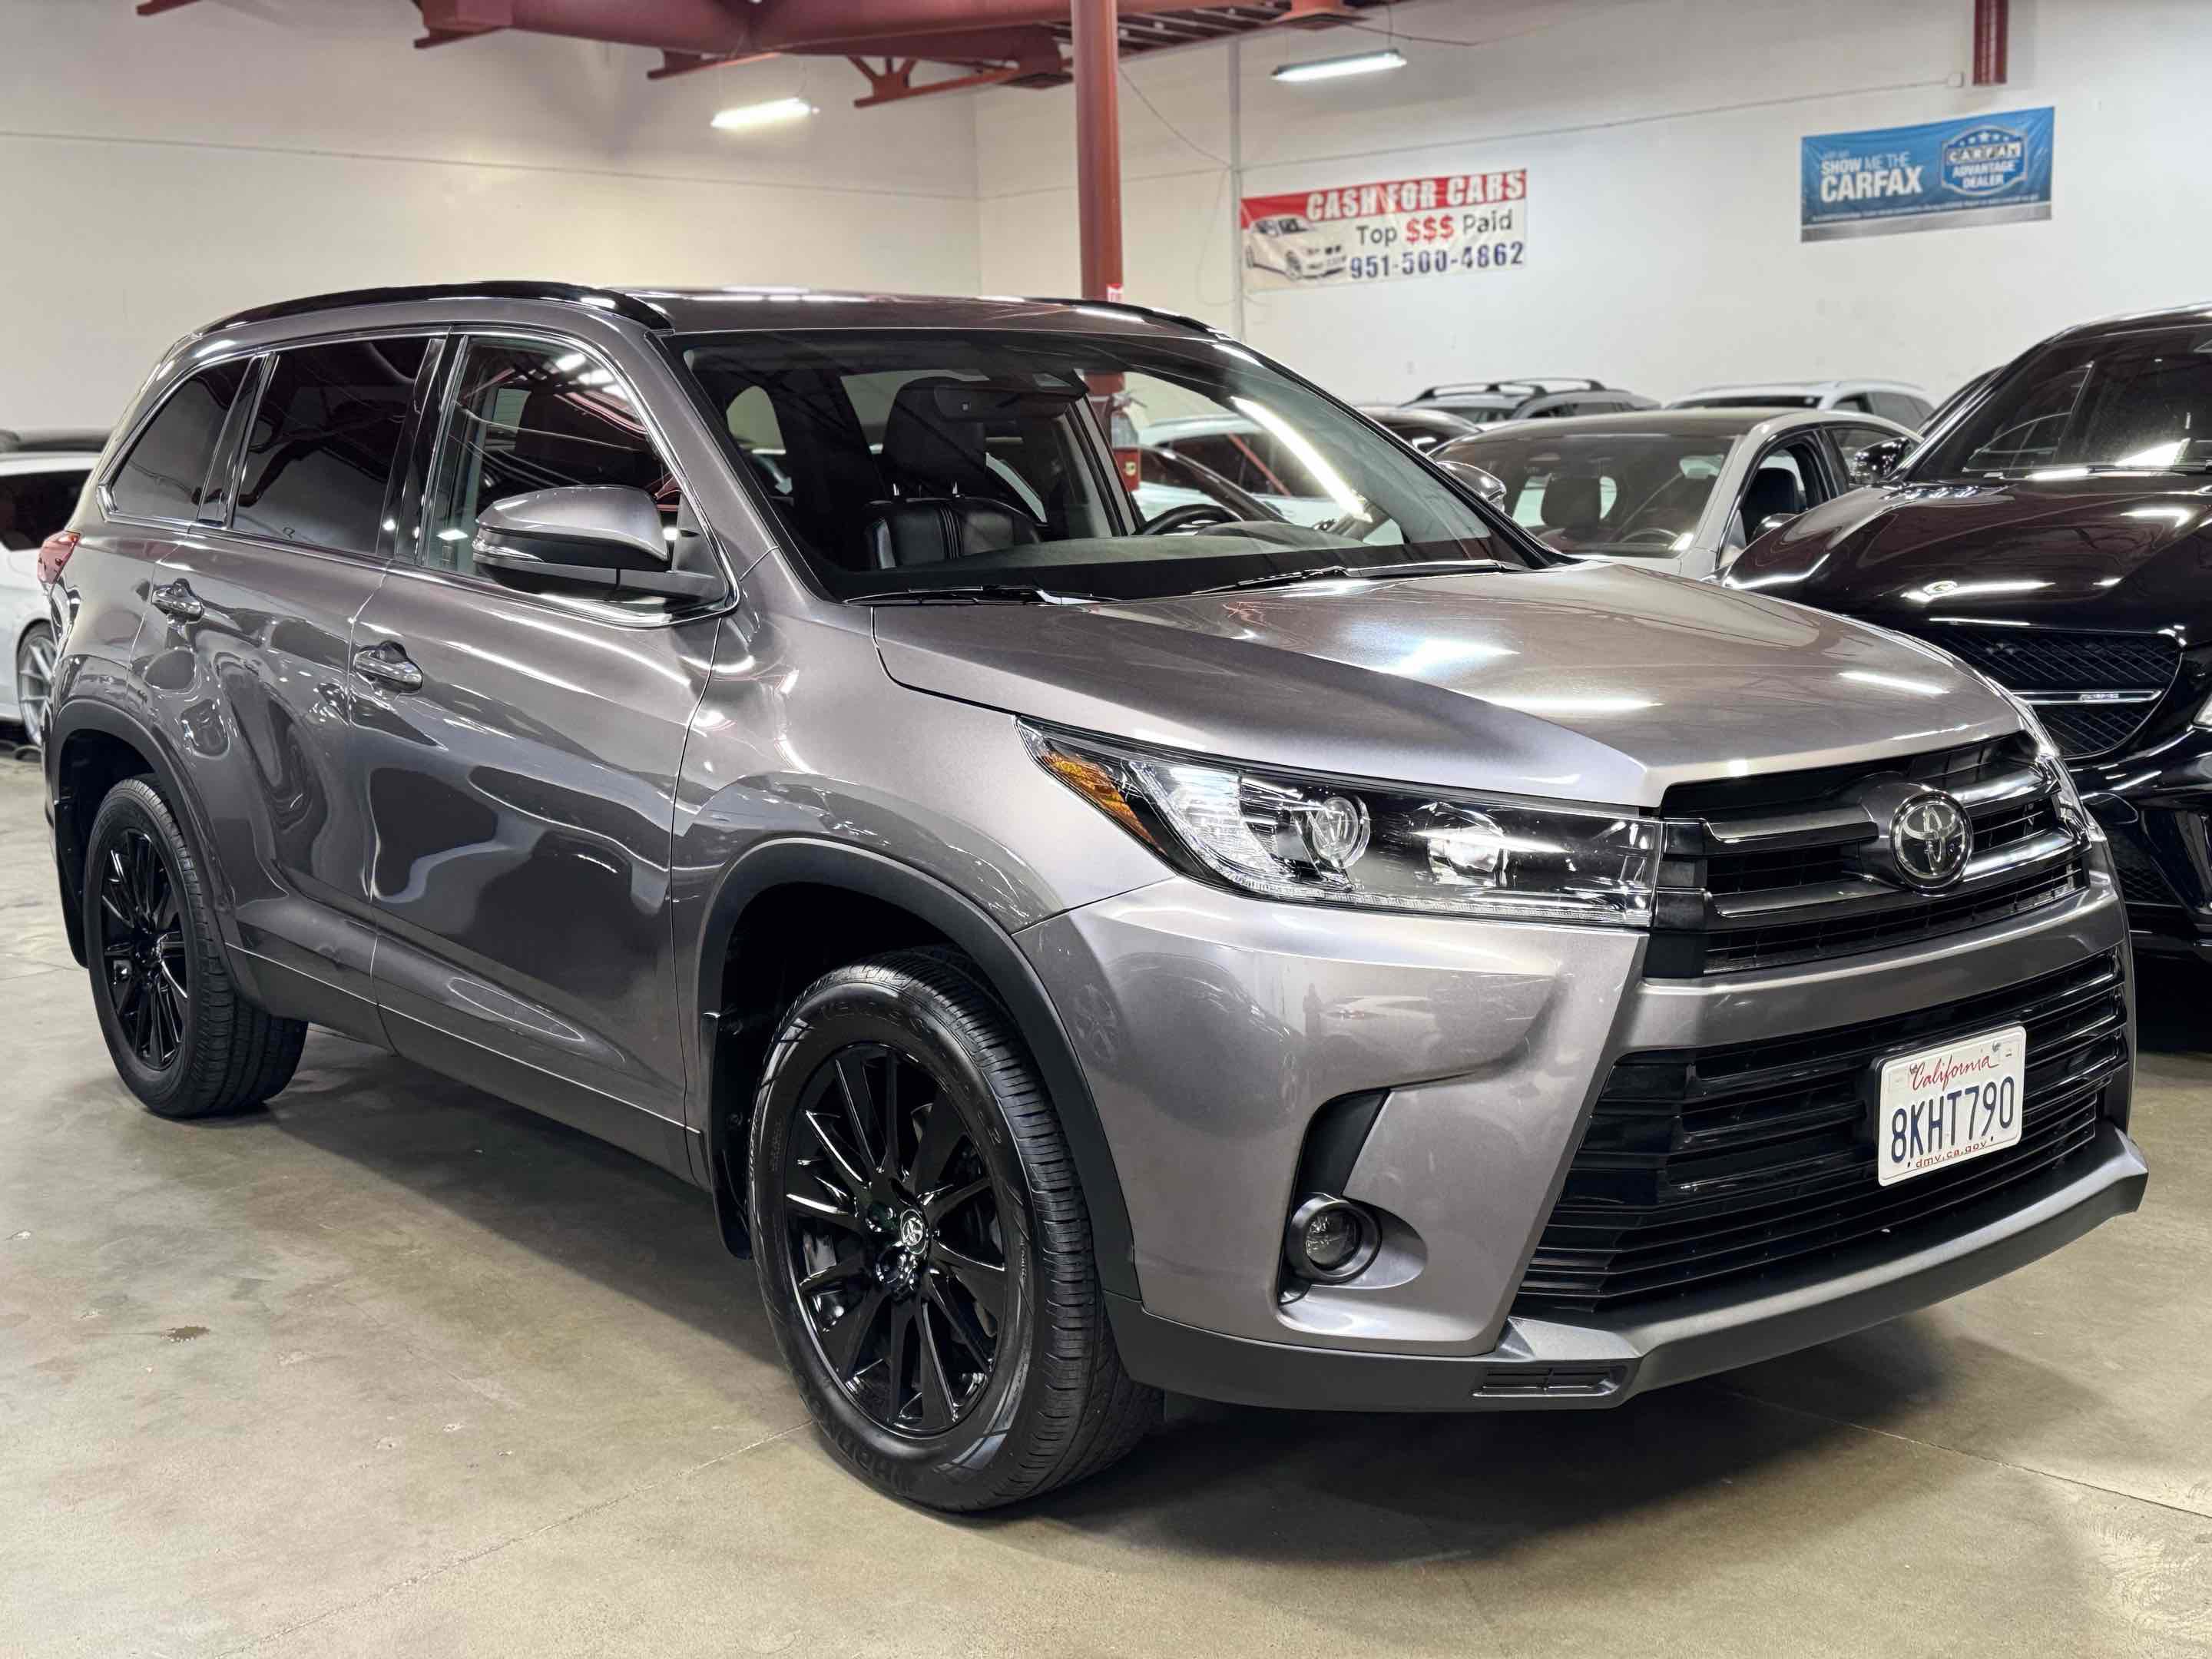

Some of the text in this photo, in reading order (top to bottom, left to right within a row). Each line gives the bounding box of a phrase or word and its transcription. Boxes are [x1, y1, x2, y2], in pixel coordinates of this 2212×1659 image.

[1821, 158, 1863, 174] SHOW
[1864, 154, 1884, 170] ME
[1886, 151, 1912, 168] THE
[1306, 171, 1526, 221] CASH FOR CARS
[1820, 165, 1924, 204] CARFAX
[1356, 209, 1512, 247] Top $$$ Paid
[1350, 240, 1525, 279] 951-500-4862
[1910, 1054, 1999, 1091] California
[1891, 1076, 2015, 1163] 8KHT790
[1916, 1140, 1987, 1167] dmv.ca.gov
